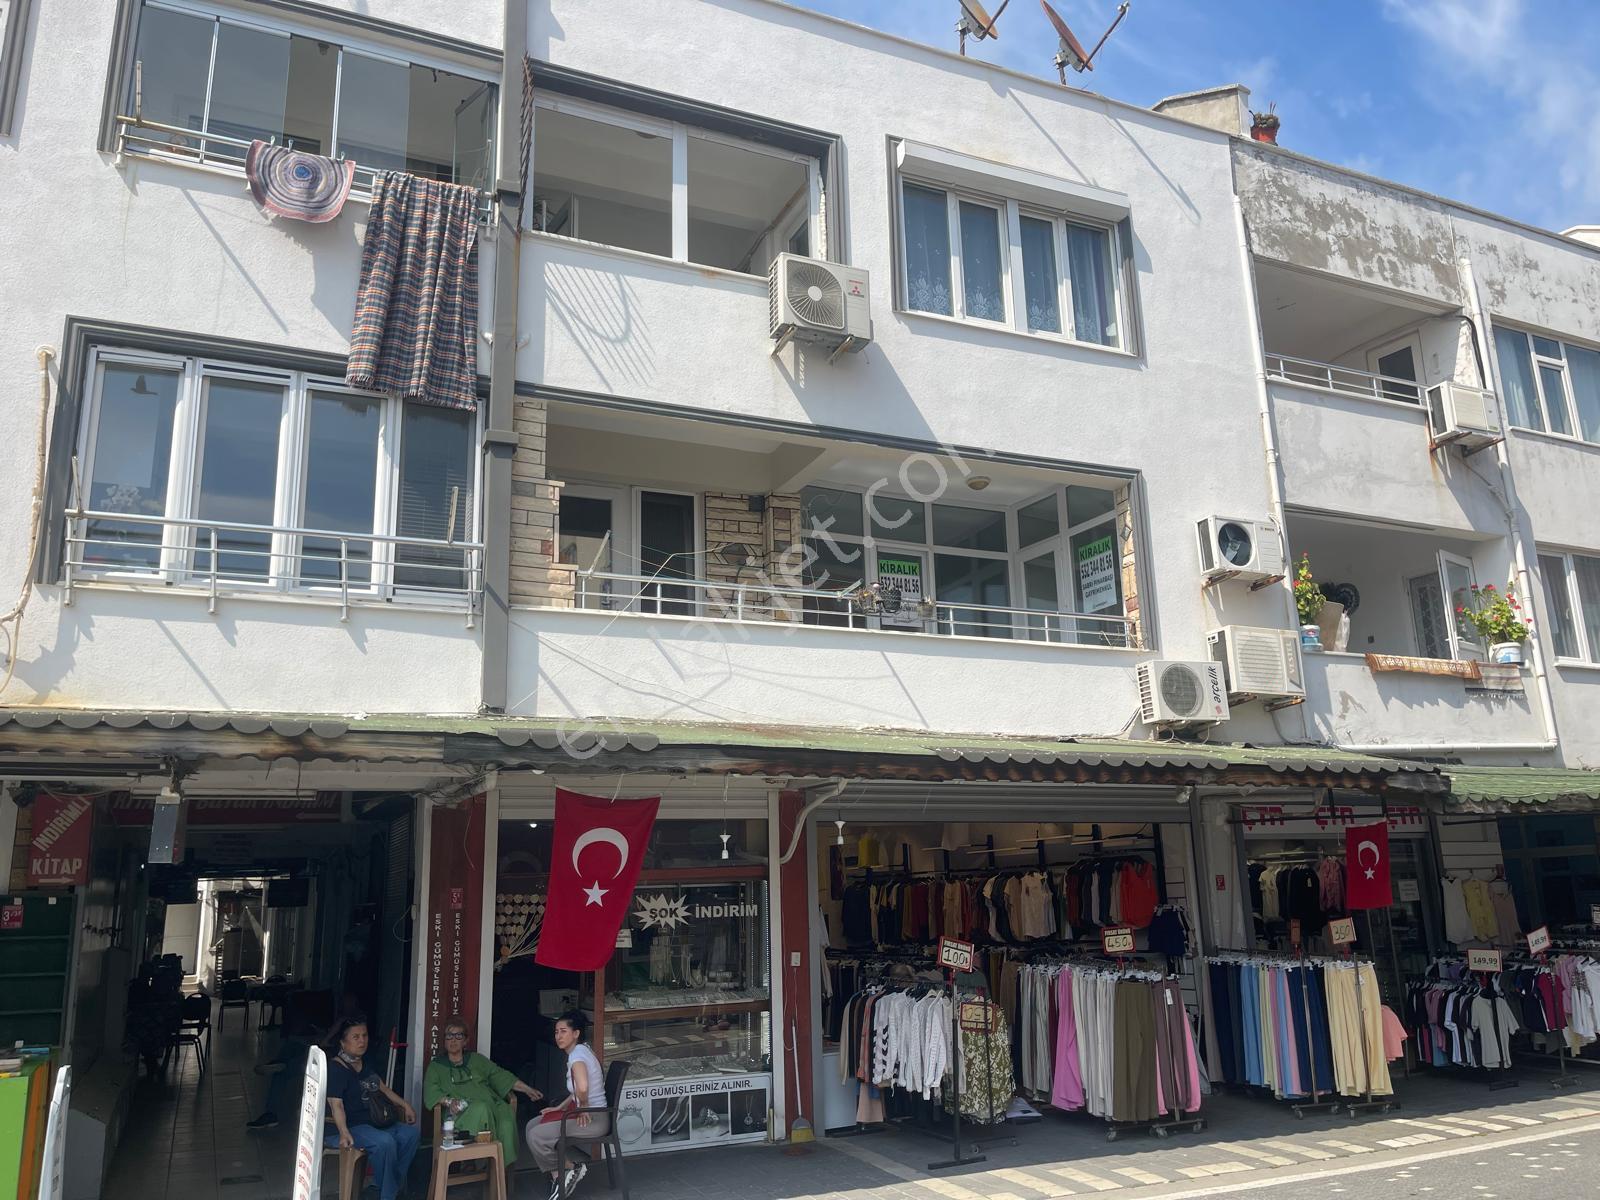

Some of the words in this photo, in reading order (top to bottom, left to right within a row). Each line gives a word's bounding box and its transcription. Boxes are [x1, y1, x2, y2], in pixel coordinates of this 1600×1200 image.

[1080, 539, 1111, 561] KİRALIK
[880, 561, 918, 575] KİRALIK
[904, 578, 911, 592] 81
[912, 579, 919, 593] 56
[1207, 666, 1221, 704] arçelik
[31, 853, 82, 875] KİTAP
[650, 907, 679, 921] ŞOK
[695, 902, 758, 918] İNDİRİM
[625, 1089, 648, 1100] ESKİ
[650, 1081, 719, 1098] GÜMÜŞLERİNİZ
[721, 1079, 753, 1090] ALINIR.
